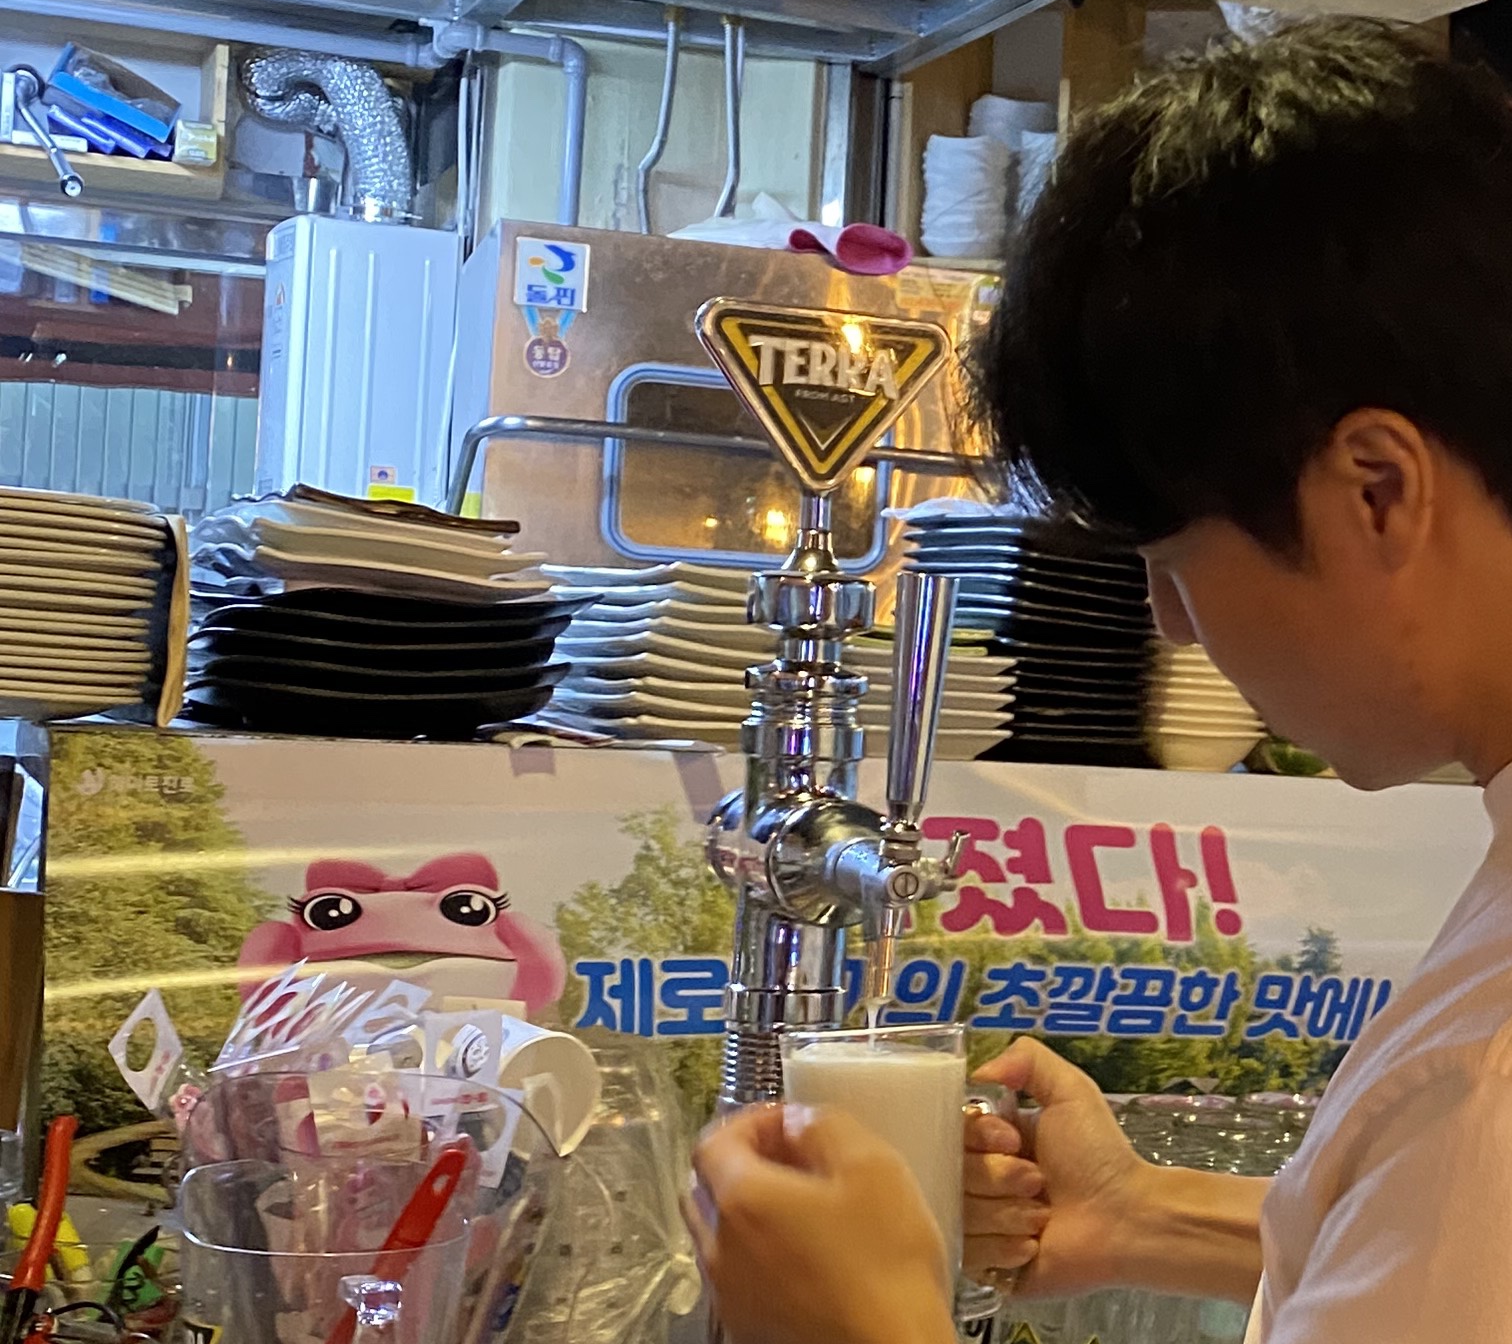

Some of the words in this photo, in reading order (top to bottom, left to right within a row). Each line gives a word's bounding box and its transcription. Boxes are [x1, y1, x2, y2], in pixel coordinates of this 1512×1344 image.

[747, 334, 898, 400] TERRA
[903, 816, 1243, 943] 졌다!
[971, 962, 1241, 1036] 초깔끔한
